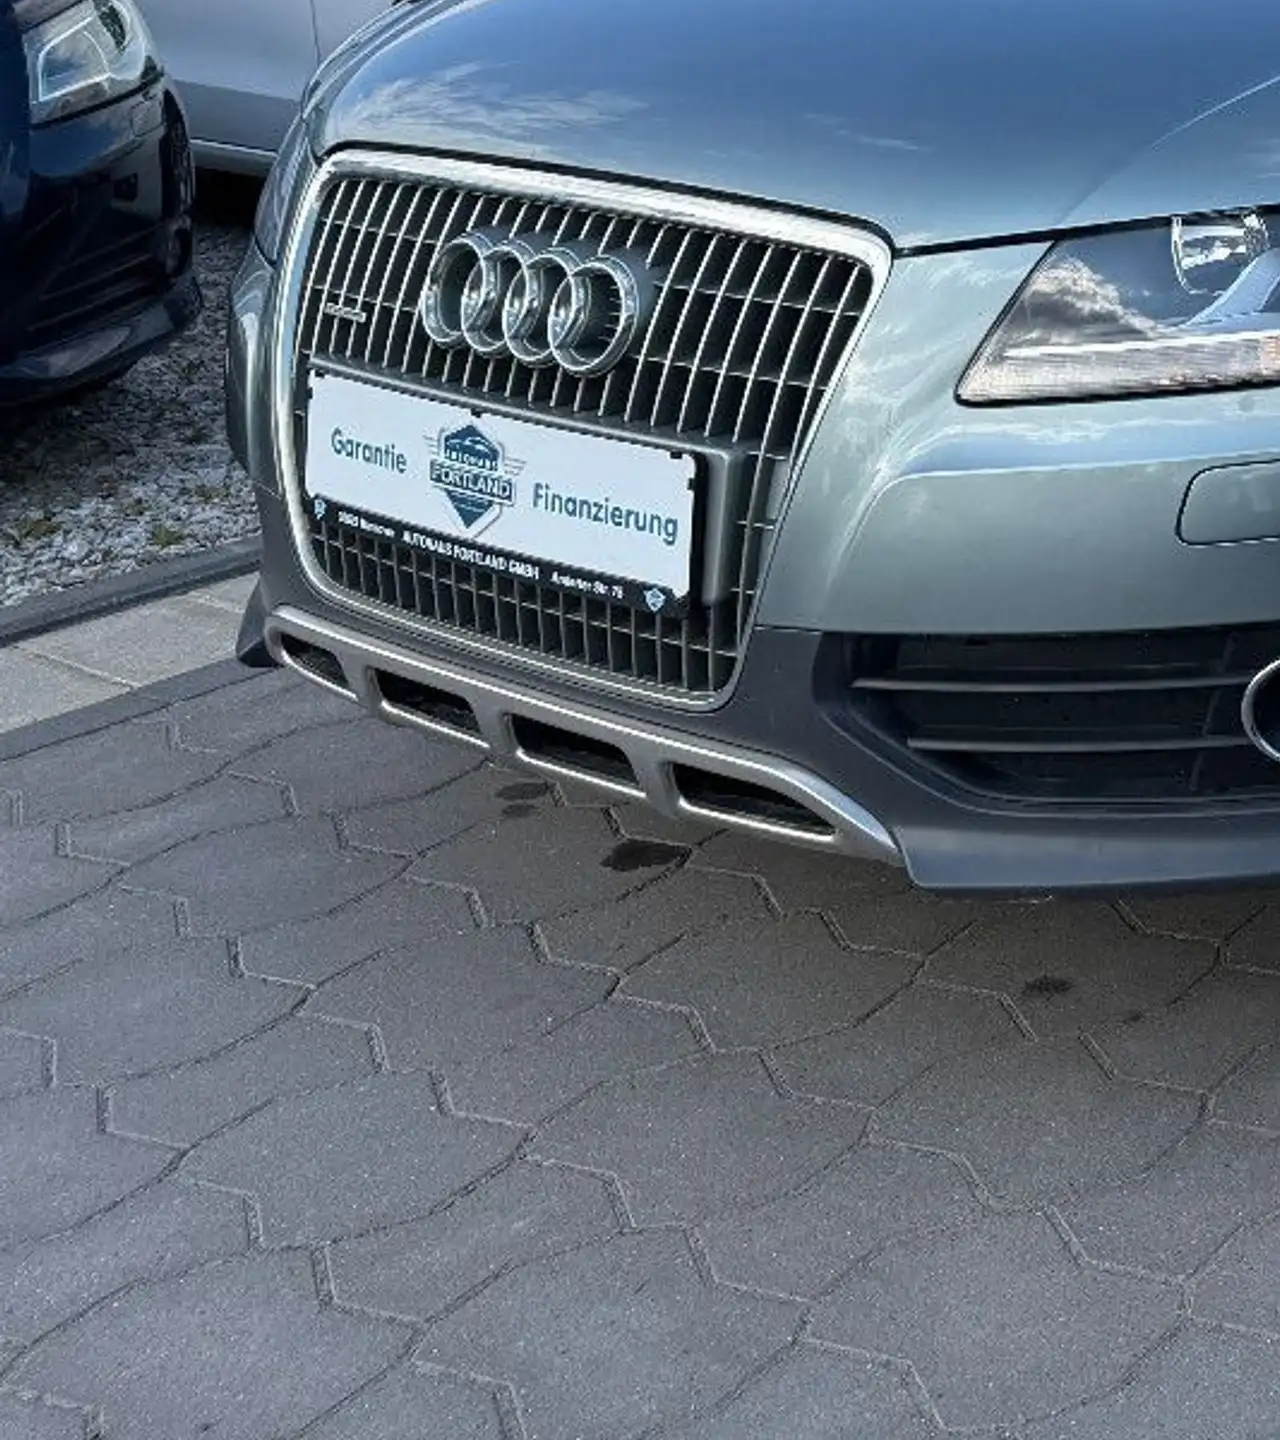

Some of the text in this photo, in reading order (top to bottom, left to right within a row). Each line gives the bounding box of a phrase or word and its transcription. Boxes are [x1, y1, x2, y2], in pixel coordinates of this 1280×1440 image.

[331, 427, 407, 474] Garantie
[431, 462, 511, 497] PORTLAND
[532, 482, 678, 546] Finanzierung
